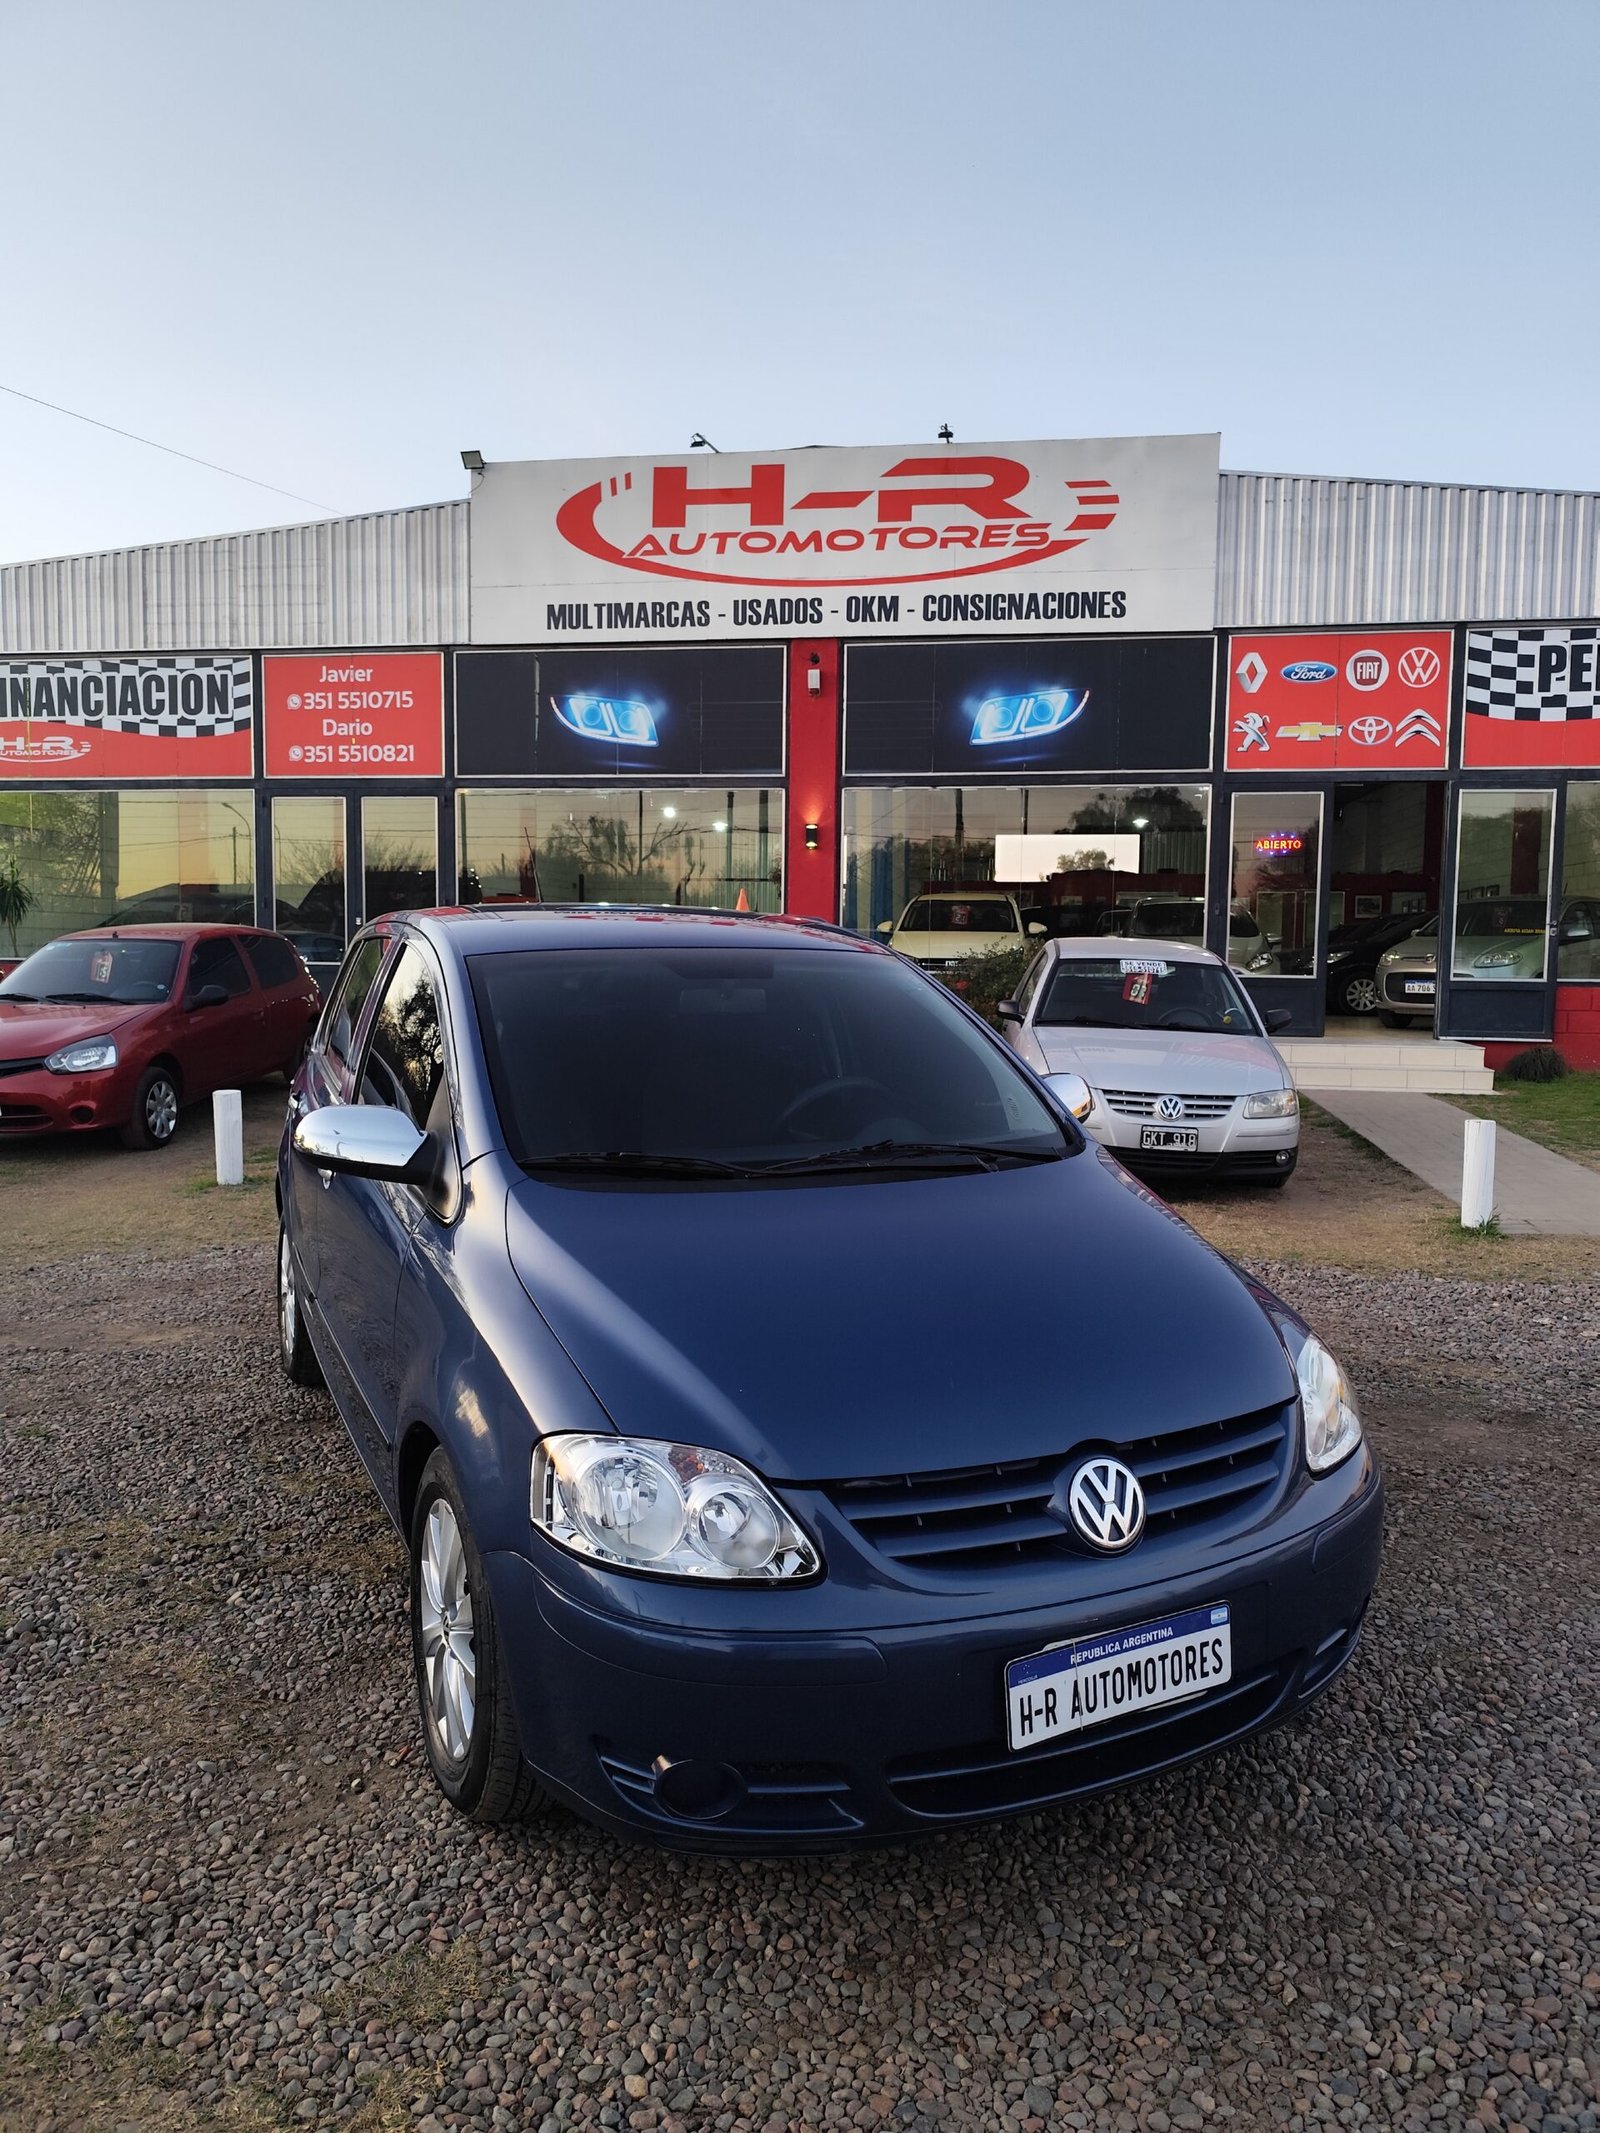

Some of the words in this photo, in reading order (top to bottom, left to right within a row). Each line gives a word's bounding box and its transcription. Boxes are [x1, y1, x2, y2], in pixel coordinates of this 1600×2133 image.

[652, 457, 1032, 528] H-R
[622, 523, 1051, 557] AUTOMOTORES
[546, 601, 710, 630] MULTIMARCAS
[733, 597, 823, 626] USADOS
[922, 591, 1127, 622] CONSIGNACIONES
[320, 665, 373, 683] Javier
[1291, 665, 1327, 680] Ford
[1356, 661, 1380, 680] FIAT
[1538, 644, 1600, 693] PE
[303, 692, 332, 710] 351
[338, 690, 414, 709] 5510715
[322, 718, 373, 736] Dario
[0, 749, 79, 757] UTOMOTORES
[304, 745, 333, 763] 351
[338, 744, 414, 762] 5510821
[1256, 840, 1302, 849] ABIERTO
[1143, 1131, 1166, 1146] GKT
[1173, 1133, 1196, 1148] 918
[1070, 1641, 1121, 1665] REPUBLICA
[1123, 1626, 1174, 1650] ARGENTINA
[1019, 1687, 1058, 1736] H-R
[1070, 1638, 1223, 1720] AUTOMOTORES
